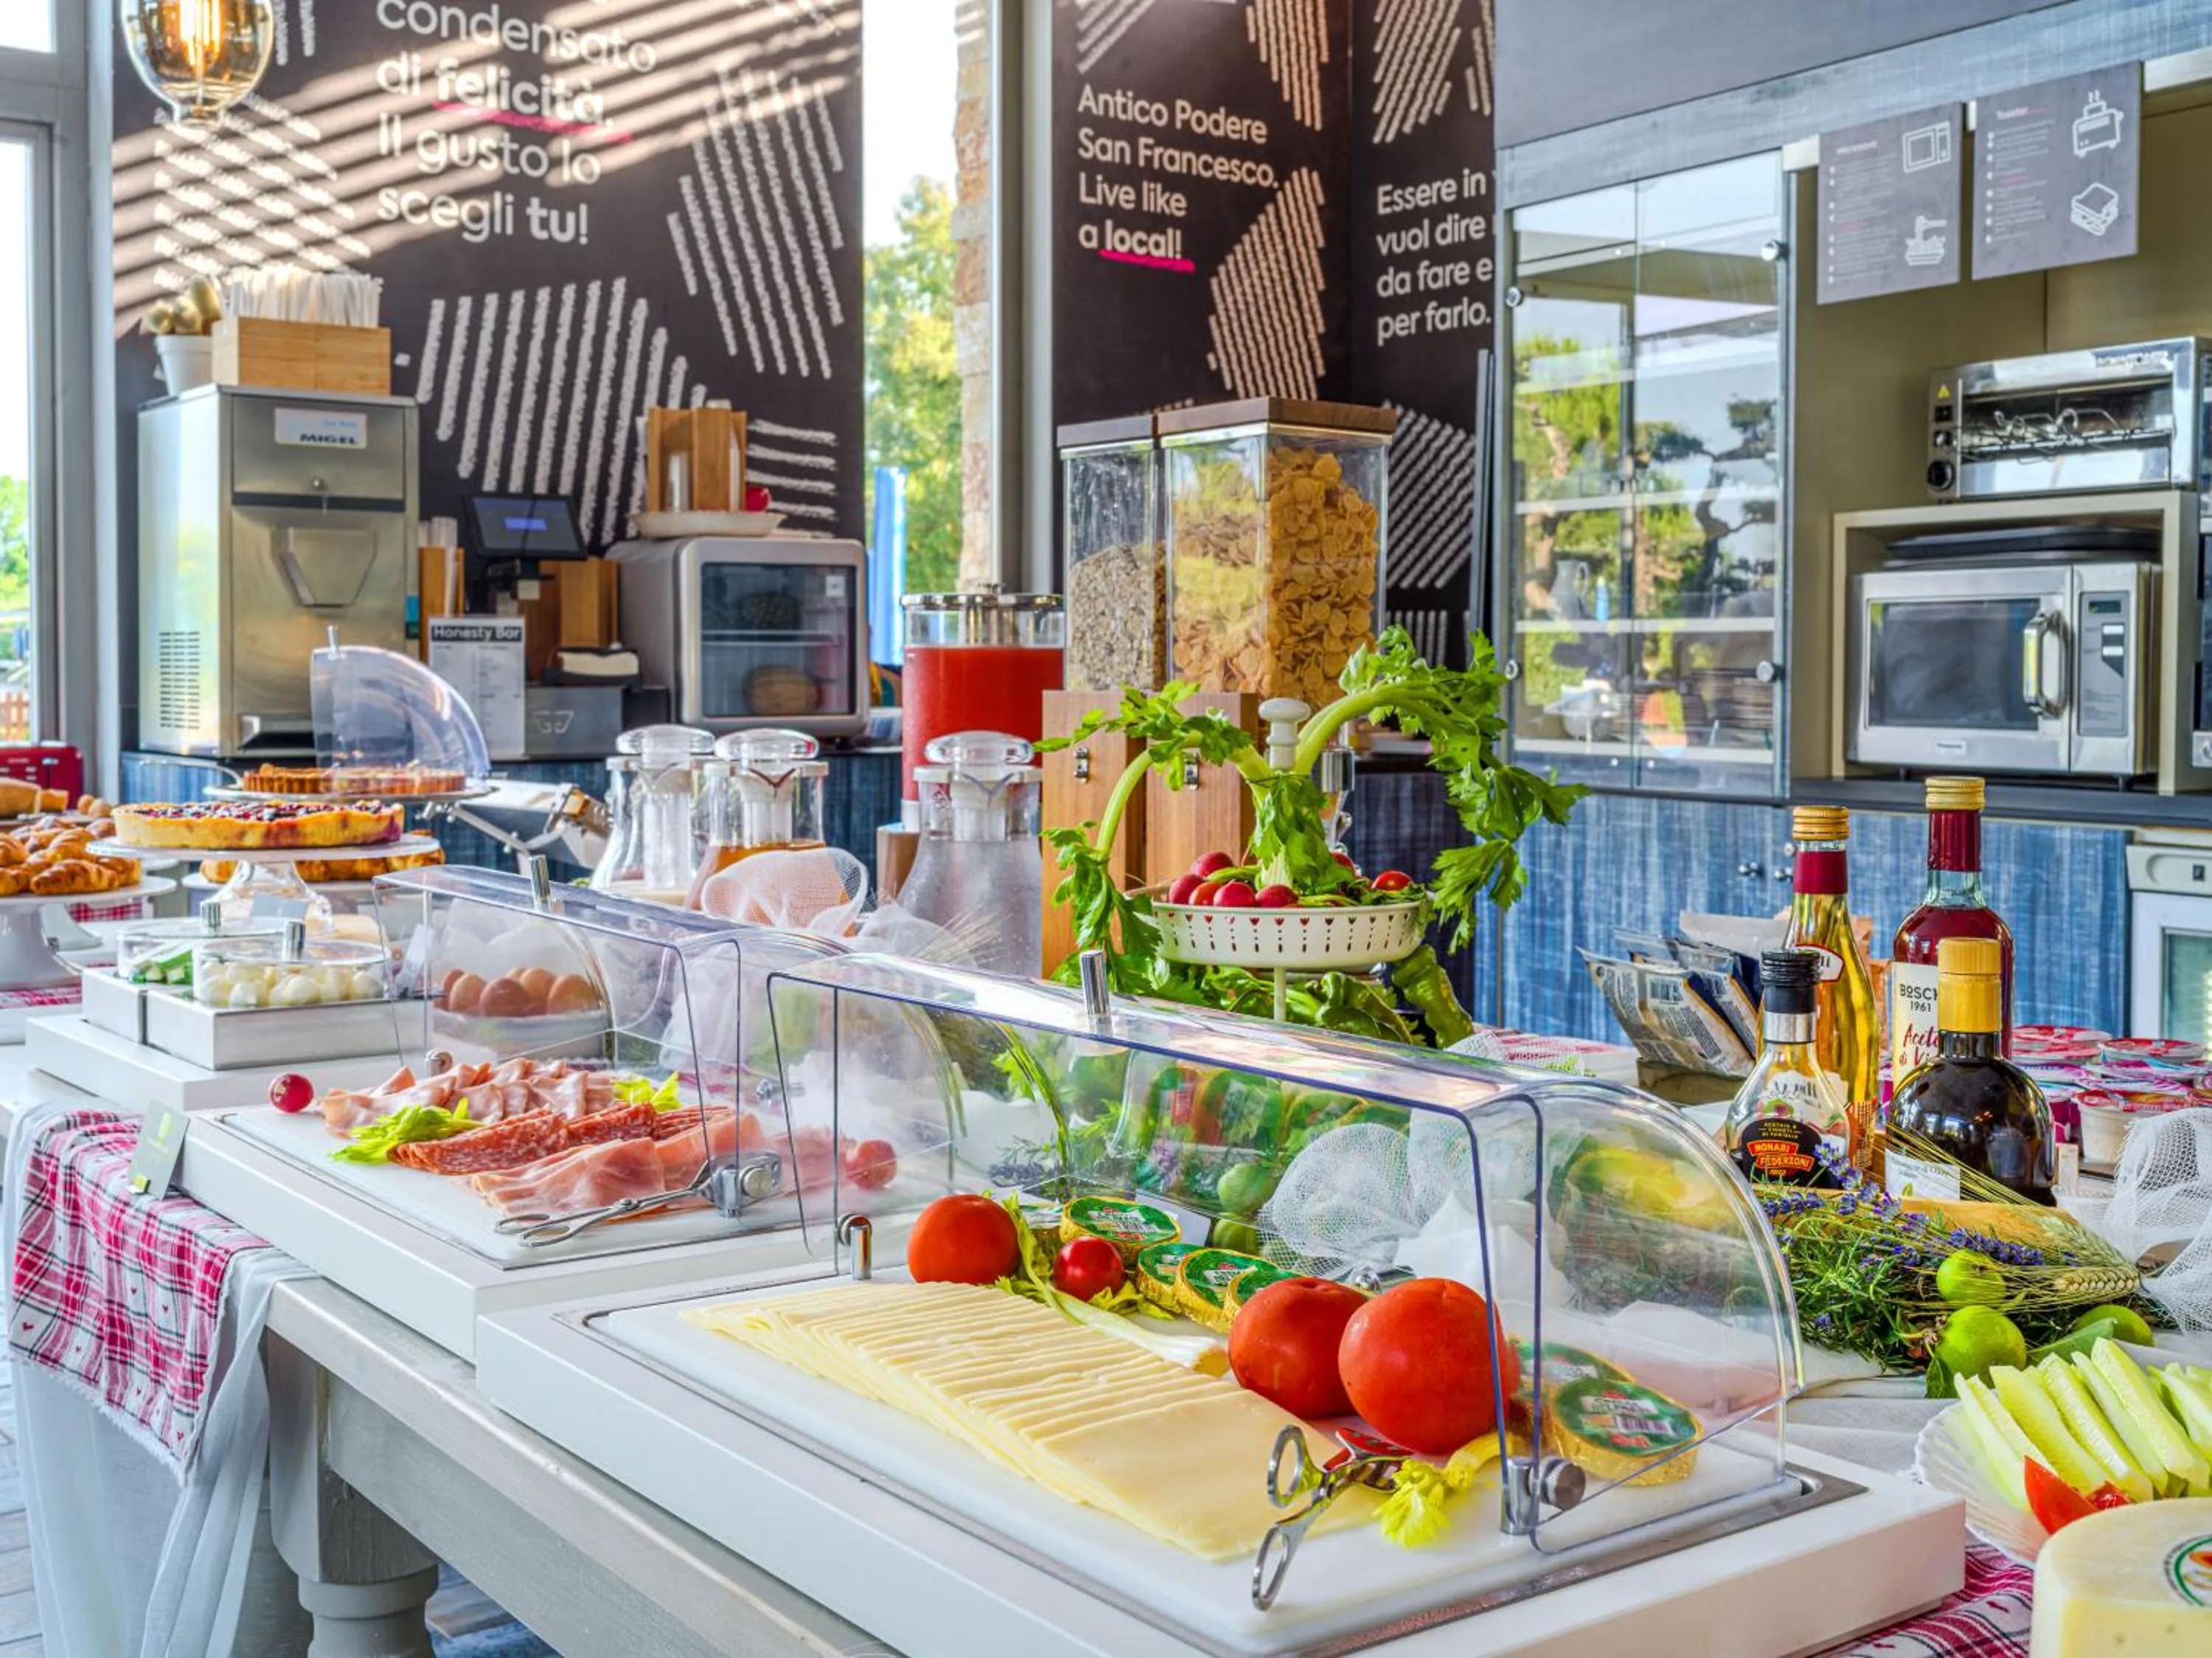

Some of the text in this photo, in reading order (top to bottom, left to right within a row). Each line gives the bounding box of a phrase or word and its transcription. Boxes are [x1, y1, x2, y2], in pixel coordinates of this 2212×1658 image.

[377, 0, 656, 72] condensato
[377, 52, 421, 96] di
[1077, 84, 1268, 144] Antico Podere
[417, 129, 549, 178] gusto
[562, 139, 601, 184] lo
[1078, 128, 1280, 188] San Francesco.
[1079, 173, 1188, 217] Live like
[1377, 176, 1457, 215] Essere
[1463, 169, 1486, 198] in
[377, 187, 588, 245] scegli tu!
[1376, 221, 1430, 257] vuol
[1434, 213, 1486, 249] dire
[1078, 219, 1183, 260] a local!
[1377, 257, 1493, 297] da fare e
[1377, 296, 1492, 347] per farlo.
[434, 626, 521, 642] Honesty Bar
[1910, 1001, 1931, 1012] 1961
